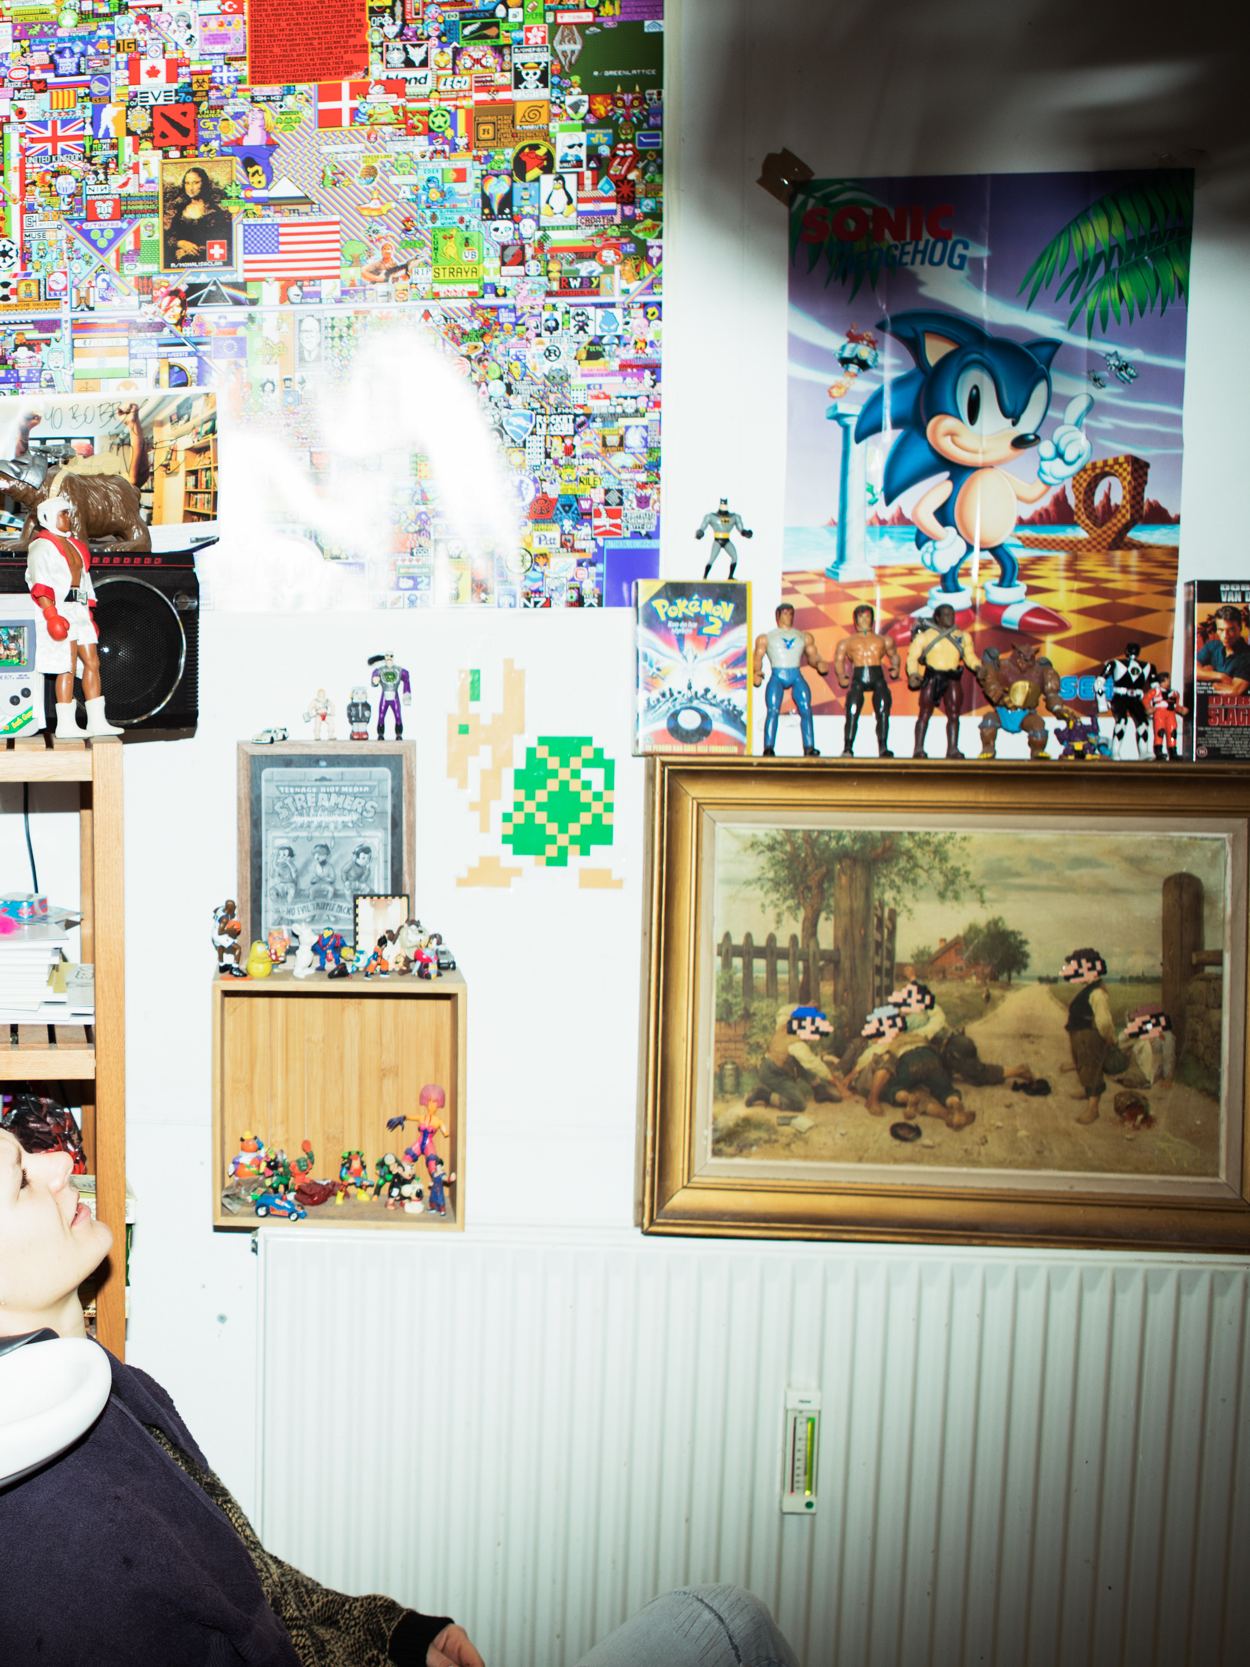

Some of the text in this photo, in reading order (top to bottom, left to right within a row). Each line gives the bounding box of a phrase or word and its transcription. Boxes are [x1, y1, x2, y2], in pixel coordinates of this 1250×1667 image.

[116, 39, 136, 52] 1G
[439, 76, 470, 90] LEGO
[138, 90, 175, 104] EVE
[514, 89, 549, 98] PIRATES
[4, 124, 25, 133] ITALY
[52, 154, 83, 162] KINGDOM
[579, 216, 614, 224] CROATIA
[801, 204, 954, 244] SONIC
[464, 251, 477, 259] VB
[838, 237, 970, 277] HEDGEHOG
[433, 267, 478, 279] STRAYA
[560, 277, 599, 289] RWBY
[578, 477, 603, 486] RILEY
[1221, 591, 1241, 602] VAN
[702, 616, 722, 635] 2
[274, 792, 379, 820] STREAMERS
[297, 905, 311, 915] EVIL
